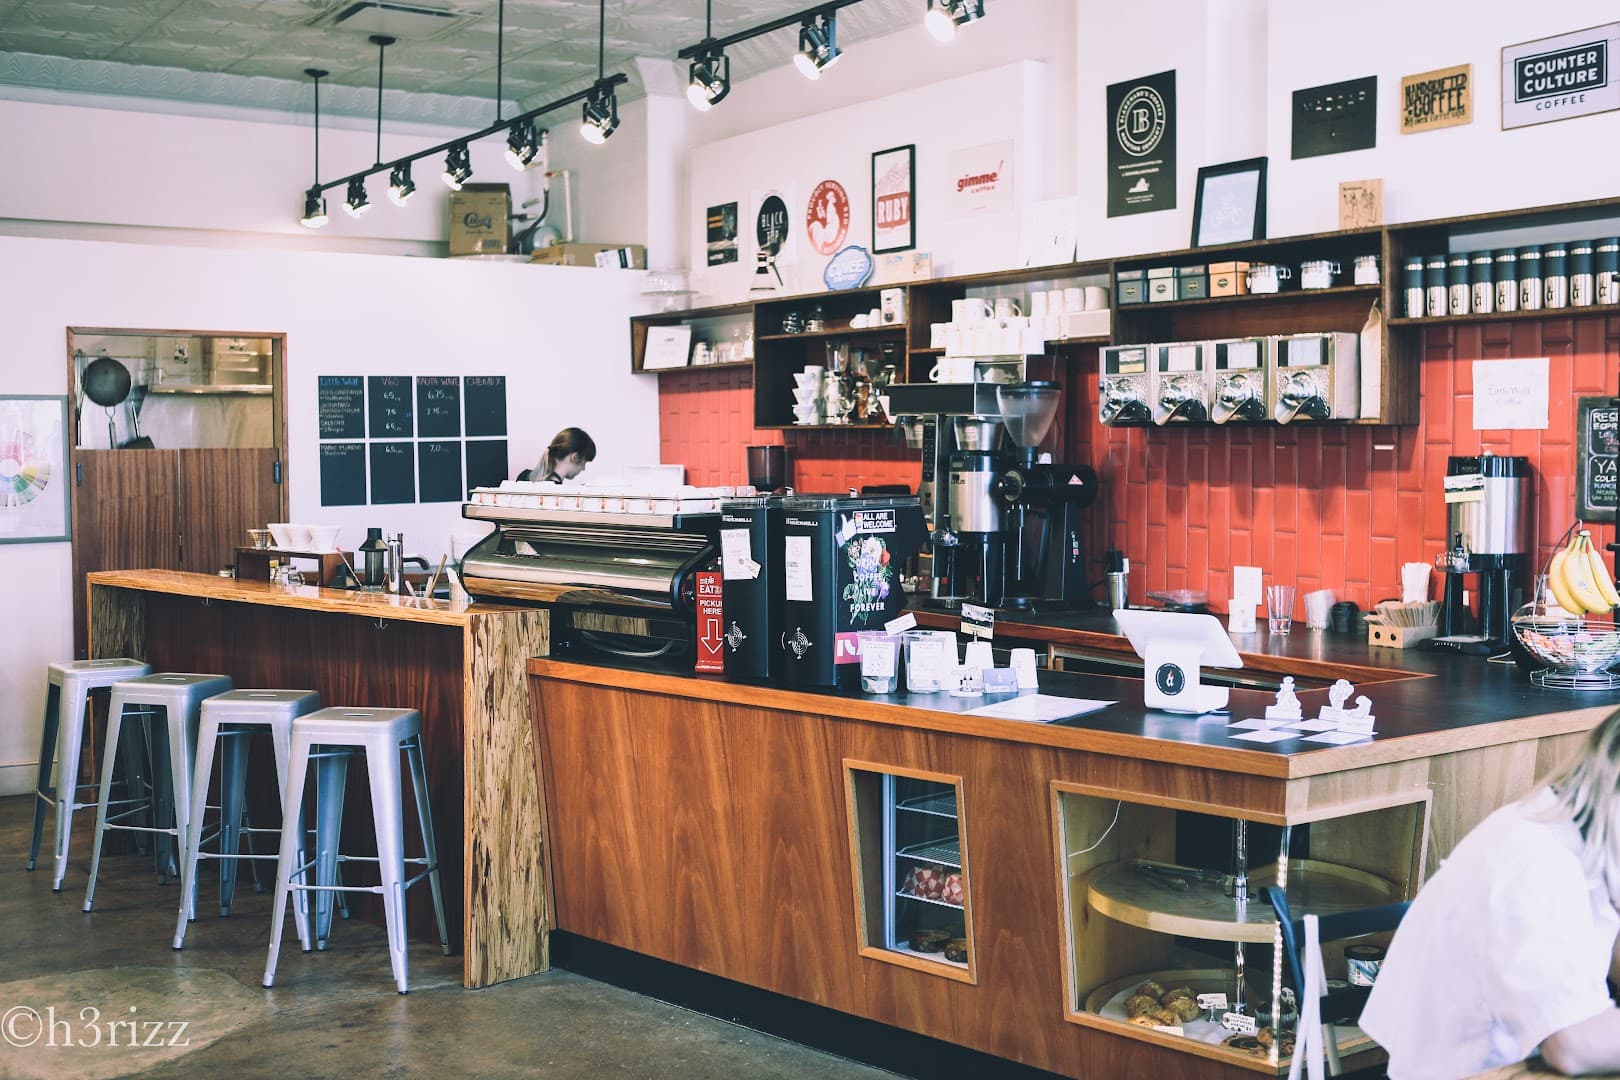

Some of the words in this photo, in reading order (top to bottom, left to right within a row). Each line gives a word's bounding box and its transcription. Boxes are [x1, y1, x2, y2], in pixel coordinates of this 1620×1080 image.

[1524, 51, 1597, 77] COUNTER
[1524, 67, 1598, 93] CULTURE
[1413, 86, 1466, 117] COFFEE
[1536, 94, 1585, 111] COFFEE
[878, 196, 909, 224] RUBY
[1593, 412, 1618, 422] RES
[864, 513, 876, 521] ALL
[876, 512, 888, 520] ARE
[864, 520, 894, 529] WELCOME
[853, 573, 882, 581] COFFEE
[850, 602, 885, 612] FOREVER
